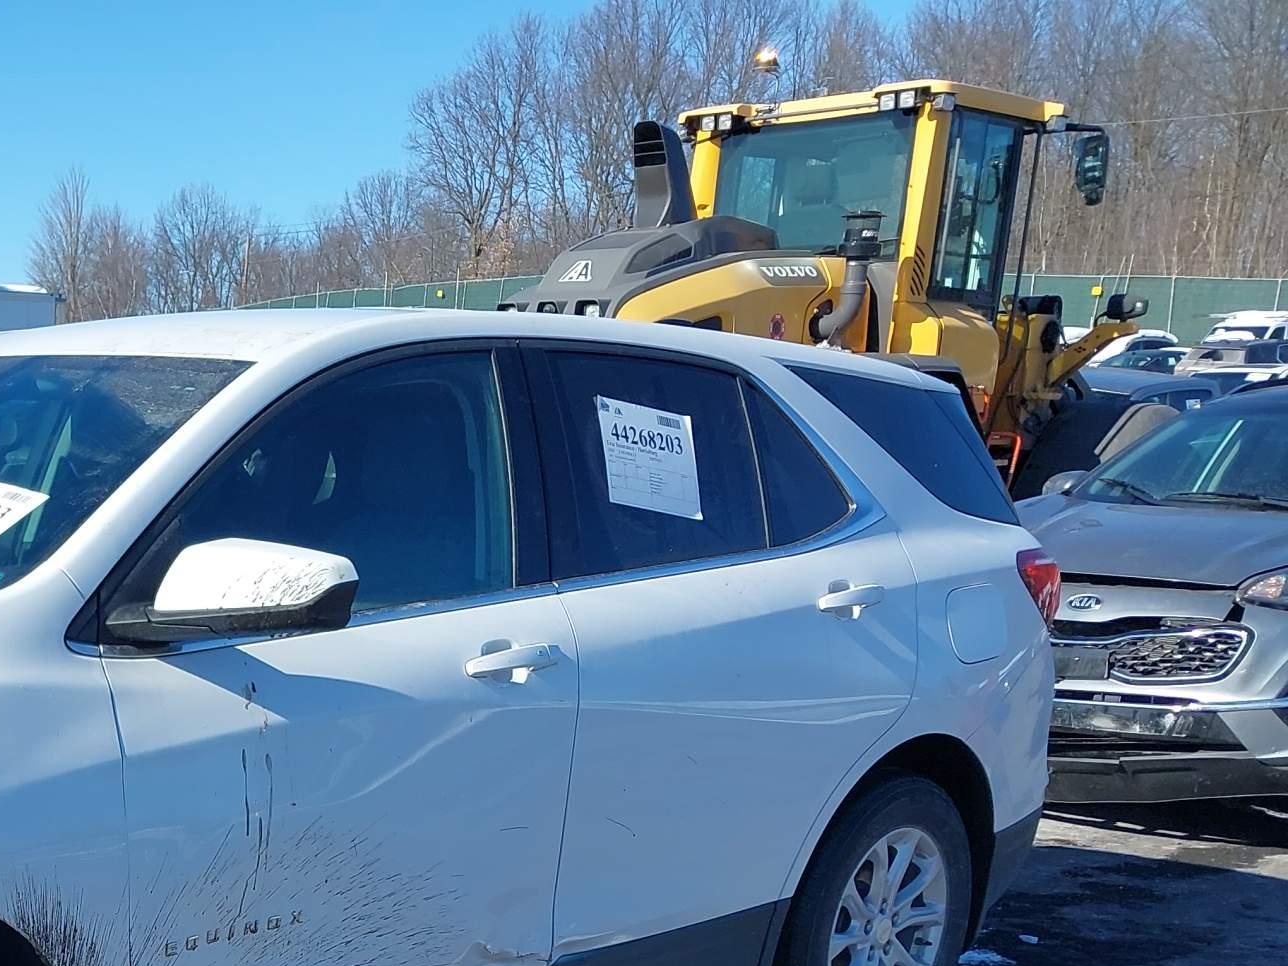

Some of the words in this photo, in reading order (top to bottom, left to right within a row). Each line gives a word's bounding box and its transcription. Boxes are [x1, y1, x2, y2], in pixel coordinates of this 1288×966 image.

[759, 265, 818, 278] VOLVO
[610, 422, 684, 456] 44268203
[1071, 597, 1097, 608] KIA
[164, 910, 305, 958] EQUINOX
